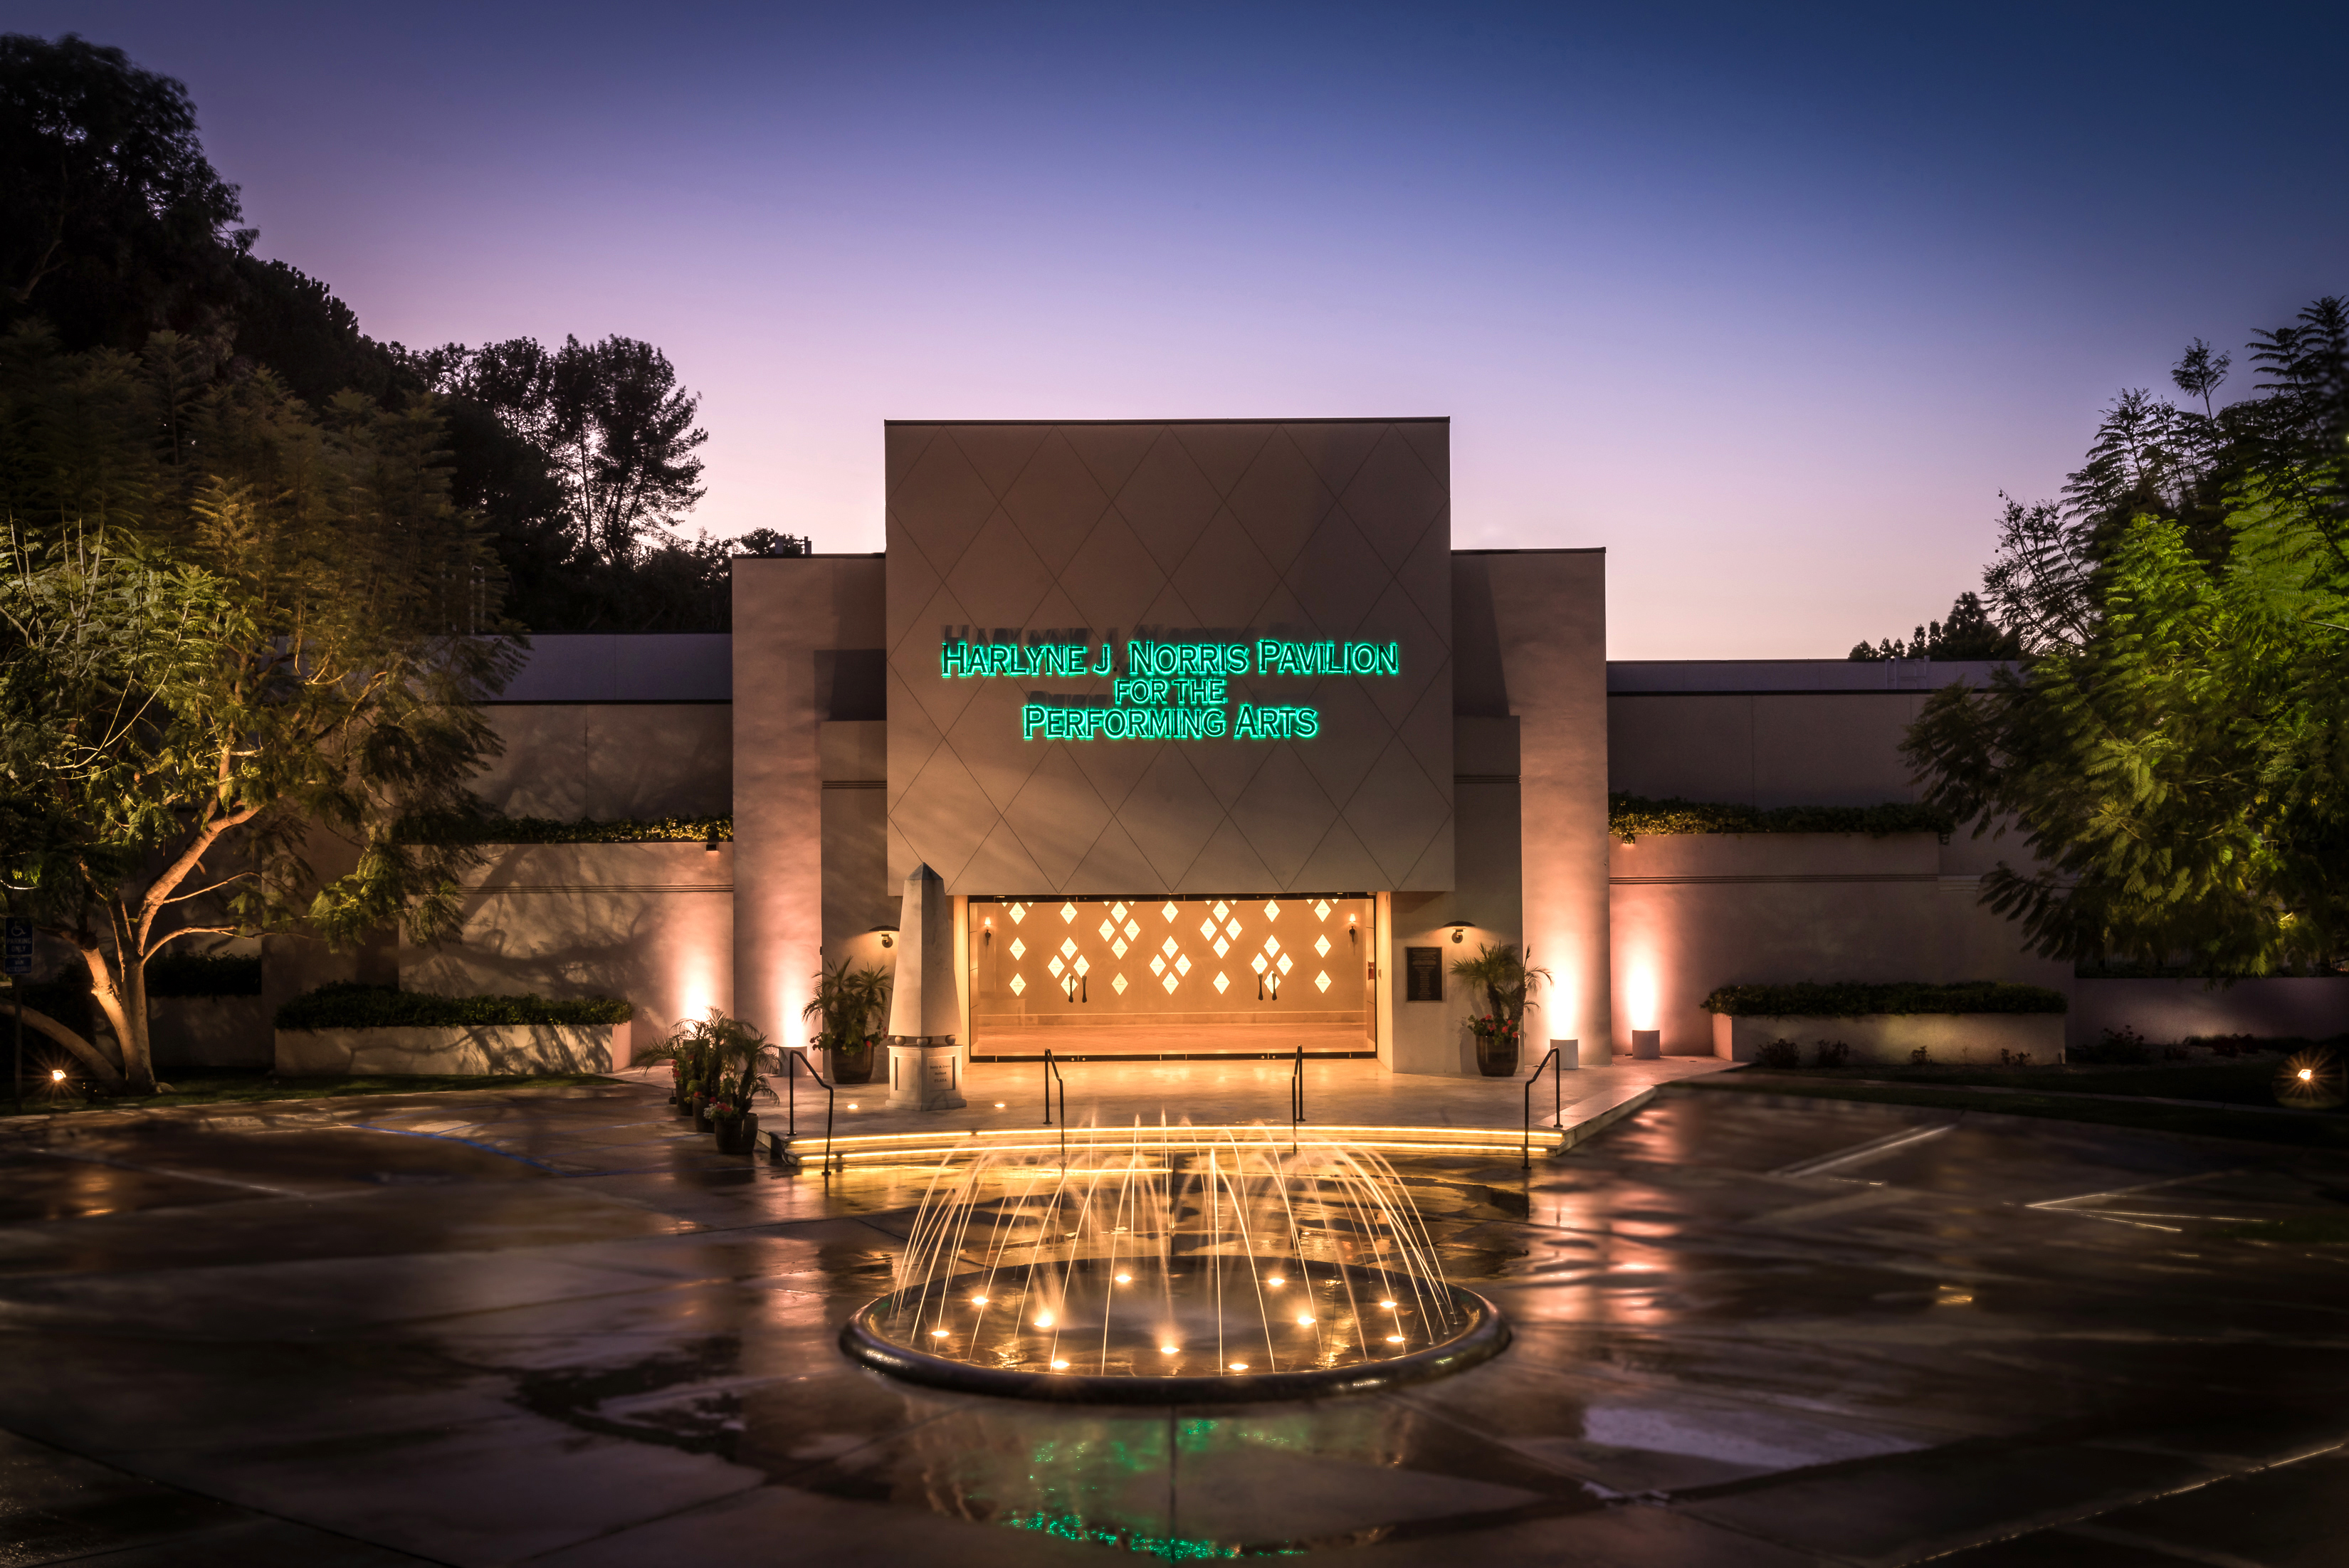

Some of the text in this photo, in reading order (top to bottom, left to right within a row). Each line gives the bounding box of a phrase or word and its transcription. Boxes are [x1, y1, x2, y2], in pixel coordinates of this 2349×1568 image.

[942, 641, 1088, 678] HARLYNE
[1128, 640, 1251, 675] NORRIS
[1256, 639, 1399, 675] PAVILION
[1114, 678, 1229, 705] FOR THE
[1021, 703, 1319, 740] PERFORMING ARTS
